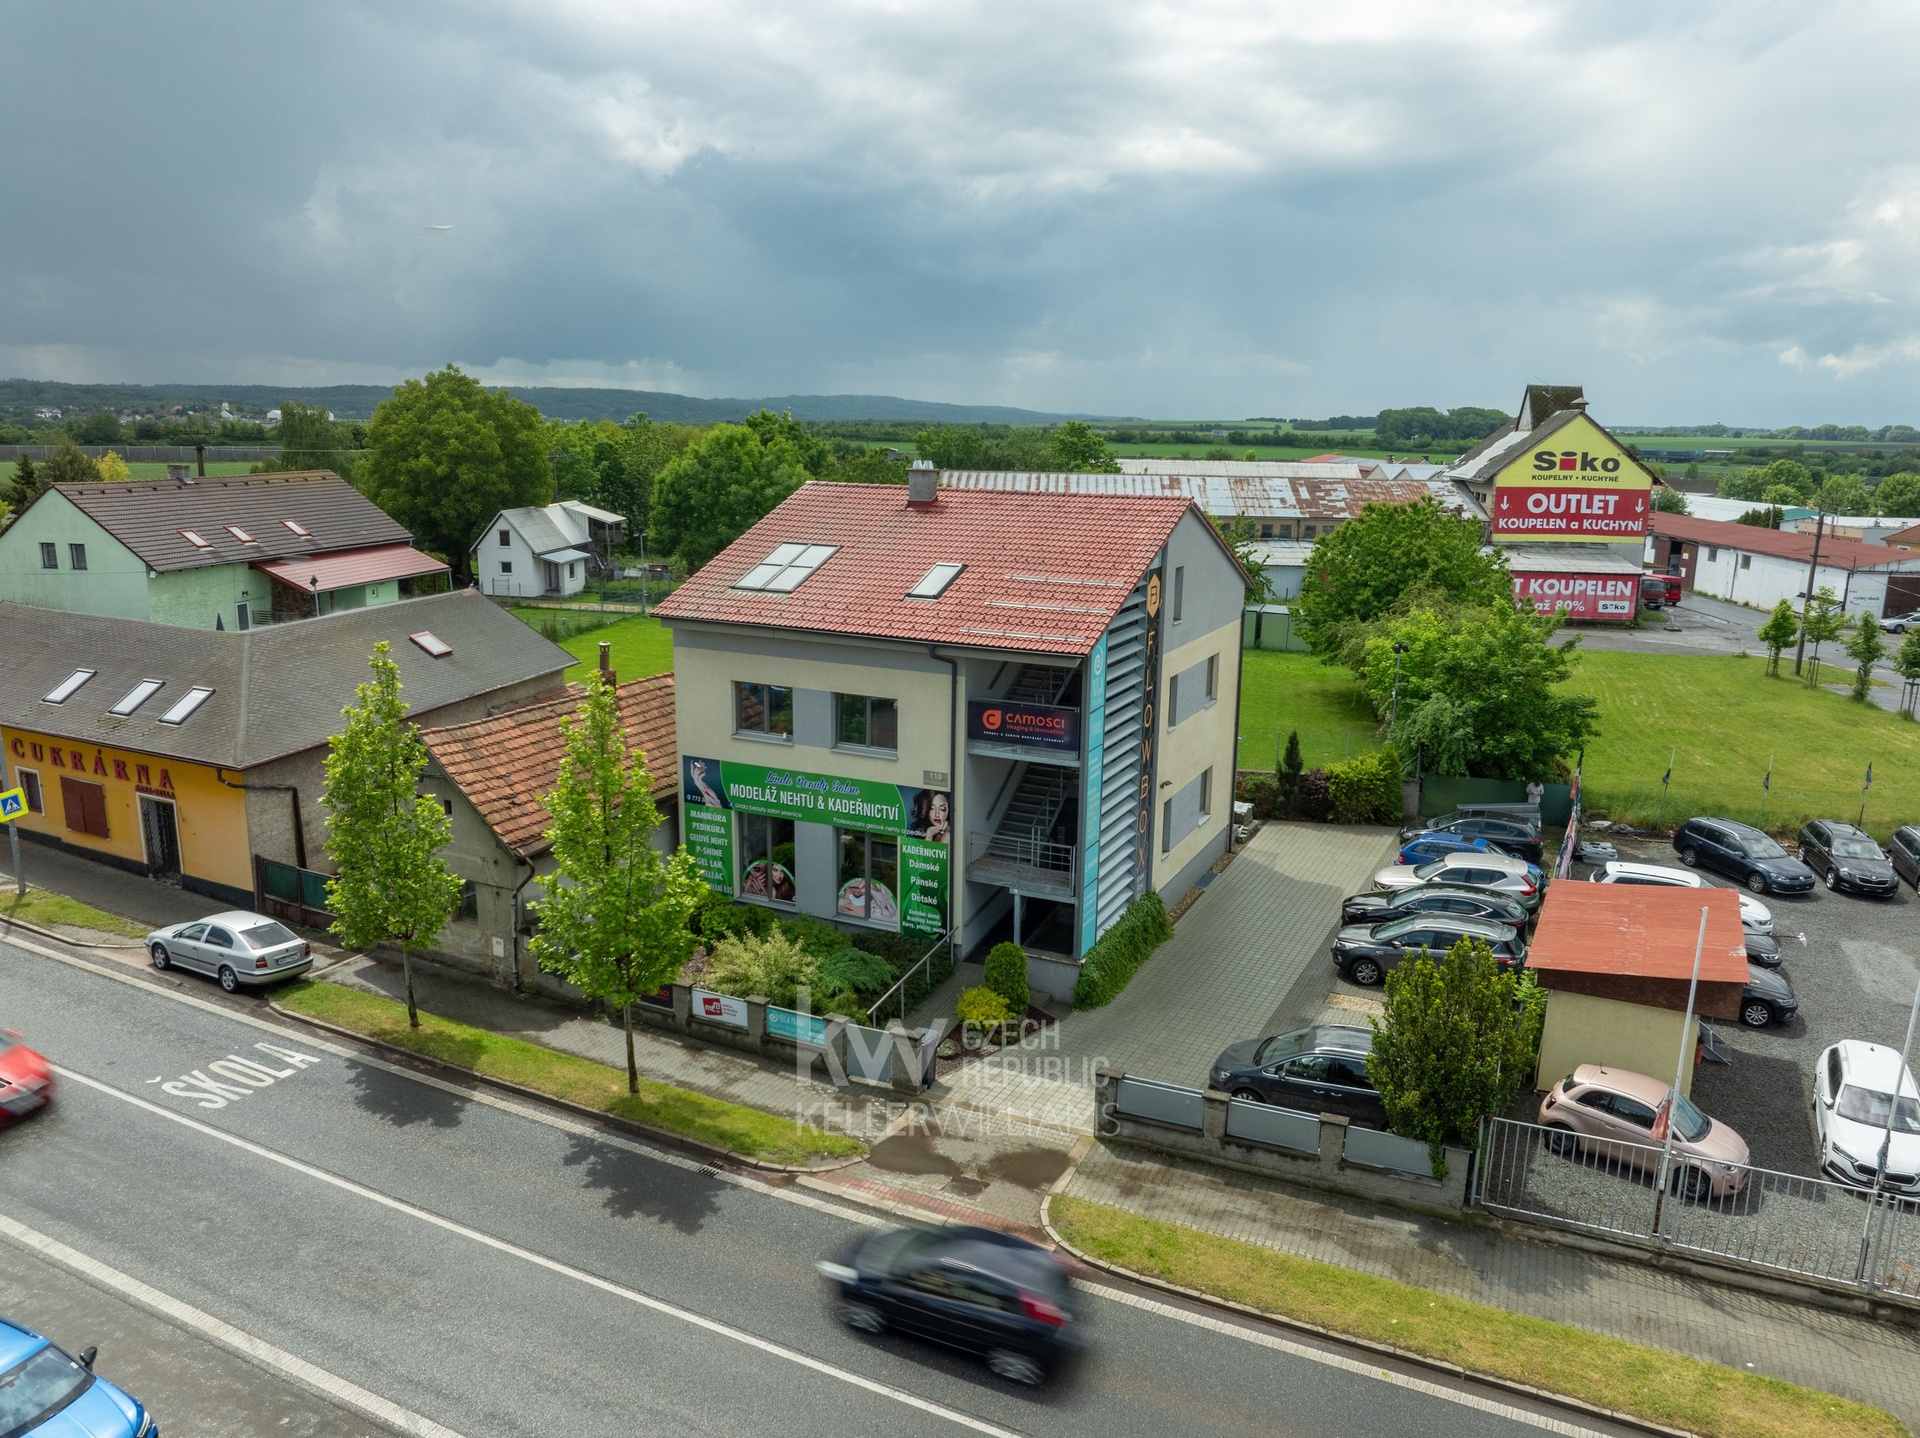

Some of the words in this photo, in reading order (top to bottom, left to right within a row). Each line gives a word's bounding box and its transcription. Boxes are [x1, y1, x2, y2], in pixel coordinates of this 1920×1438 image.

[1527, 493, 1619, 515] OUTLET
[1499, 518, 1566, 529] KOUPELEN
[1570, 521, 1579, 530] a
[1583, 518, 1643, 531] KUCHYNÍ
[1529, 578, 1632, 596] KOUPELEN
[1535, 599, 1550, 610] až
[1555, 600, 1585, 611] 80%
[1006, 713, 1065, 729] CAMOSCI
[11, 738, 175, 790] CUKRÁRNA
[929, 772, 943, 781] 118
[765, 771, 793, 786] Linda
[796, 776, 829, 793] Beauty
[832, 780, 860, 796] Salon
[730, 783, 777, 803] MODELÁŽ
[780, 791, 814, 809] NEHTŮ
[817, 796, 826, 810] &
[828, 798, 901, 821] KADEŘNICTVÍ
[690, 810, 726, 822] MANIKÚRA
[749, 805, 766, 814] beauty
[767, 807, 780, 815] salon
[692, 822, 725, 834] PEDIKÚRA
[690, 833, 710, 843] GELOVÉ
[711, 837, 728, 846] NEHTY
[696, 846, 722, 857] P-SHINE
[902, 844, 947, 859] KADEŘNICTVÍ
[697, 857, 708, 866] GEL
[710, 859, 722, 868] LAK
[909, 859, 940, 872] Dámské
[910, 876, 938, 889] Pánské
[911, 893, 938, 905] Dětské
[145, 1042, 321, 1109] ŠKOLA
